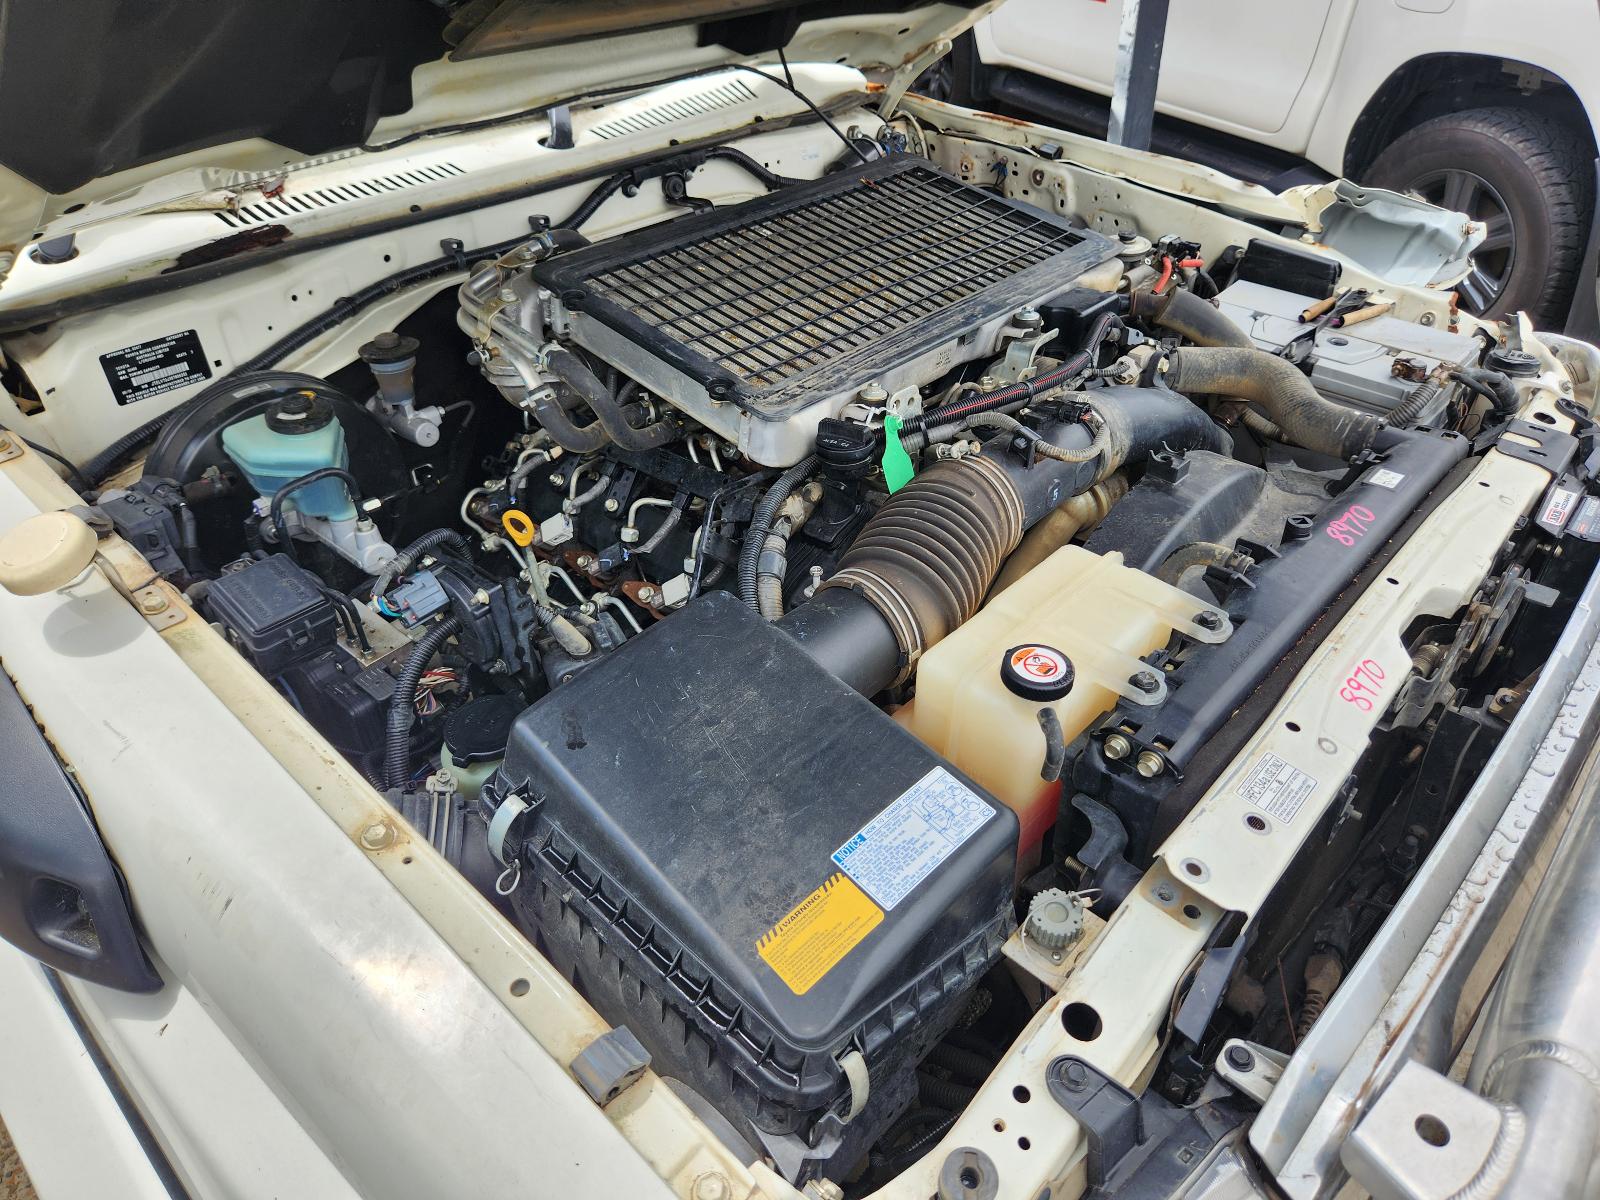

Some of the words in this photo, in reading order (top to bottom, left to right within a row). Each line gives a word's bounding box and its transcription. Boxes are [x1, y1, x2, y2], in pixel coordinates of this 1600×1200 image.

[1326, 505, 1376, 546] 8970
[1340, 659, 1386, 712] 8970
[837, 836, 864, 861] NOTICE
[865, 825, 877, 836] HOW
[877, 818, 885, 826] TO
[884, 802, 903, 819] CHANGE
[902, 785, 923, 804] COOLANT
[782, 893, 821, 928] WARNING
